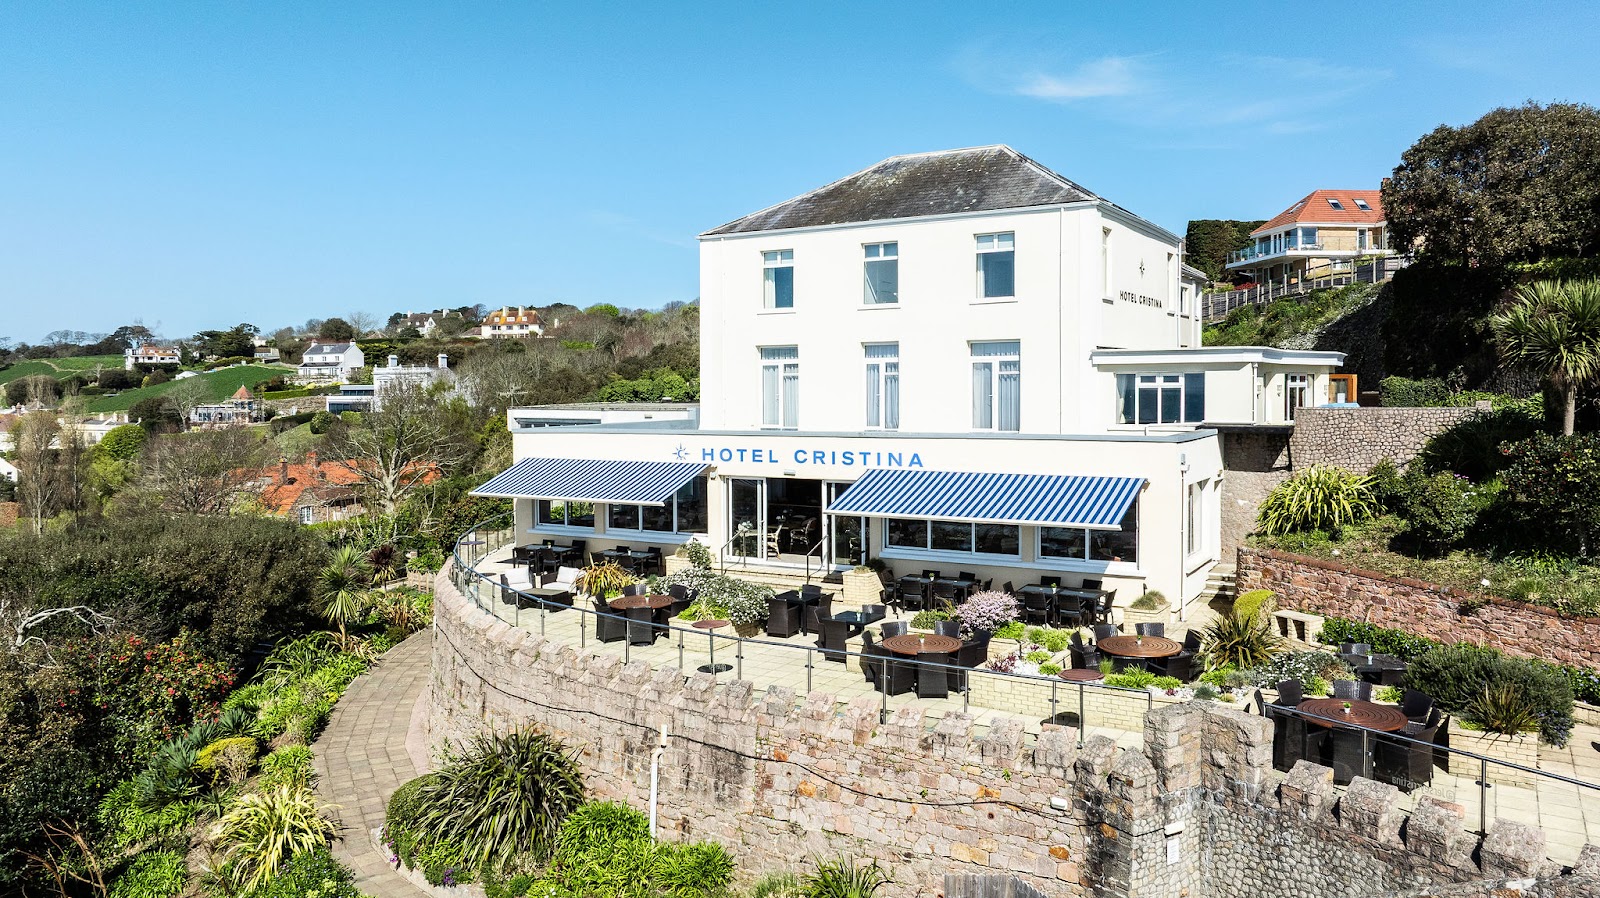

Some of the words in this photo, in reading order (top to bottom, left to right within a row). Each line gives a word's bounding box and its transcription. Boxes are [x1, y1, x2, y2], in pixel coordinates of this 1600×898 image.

[1120, 290, 1137, 304] HOTEL
[1139, 295, 1162, 309] CRISTINA
[701, 448, 779, 463] HOTEL
[794, 449, 924, 468] CRISTINA
